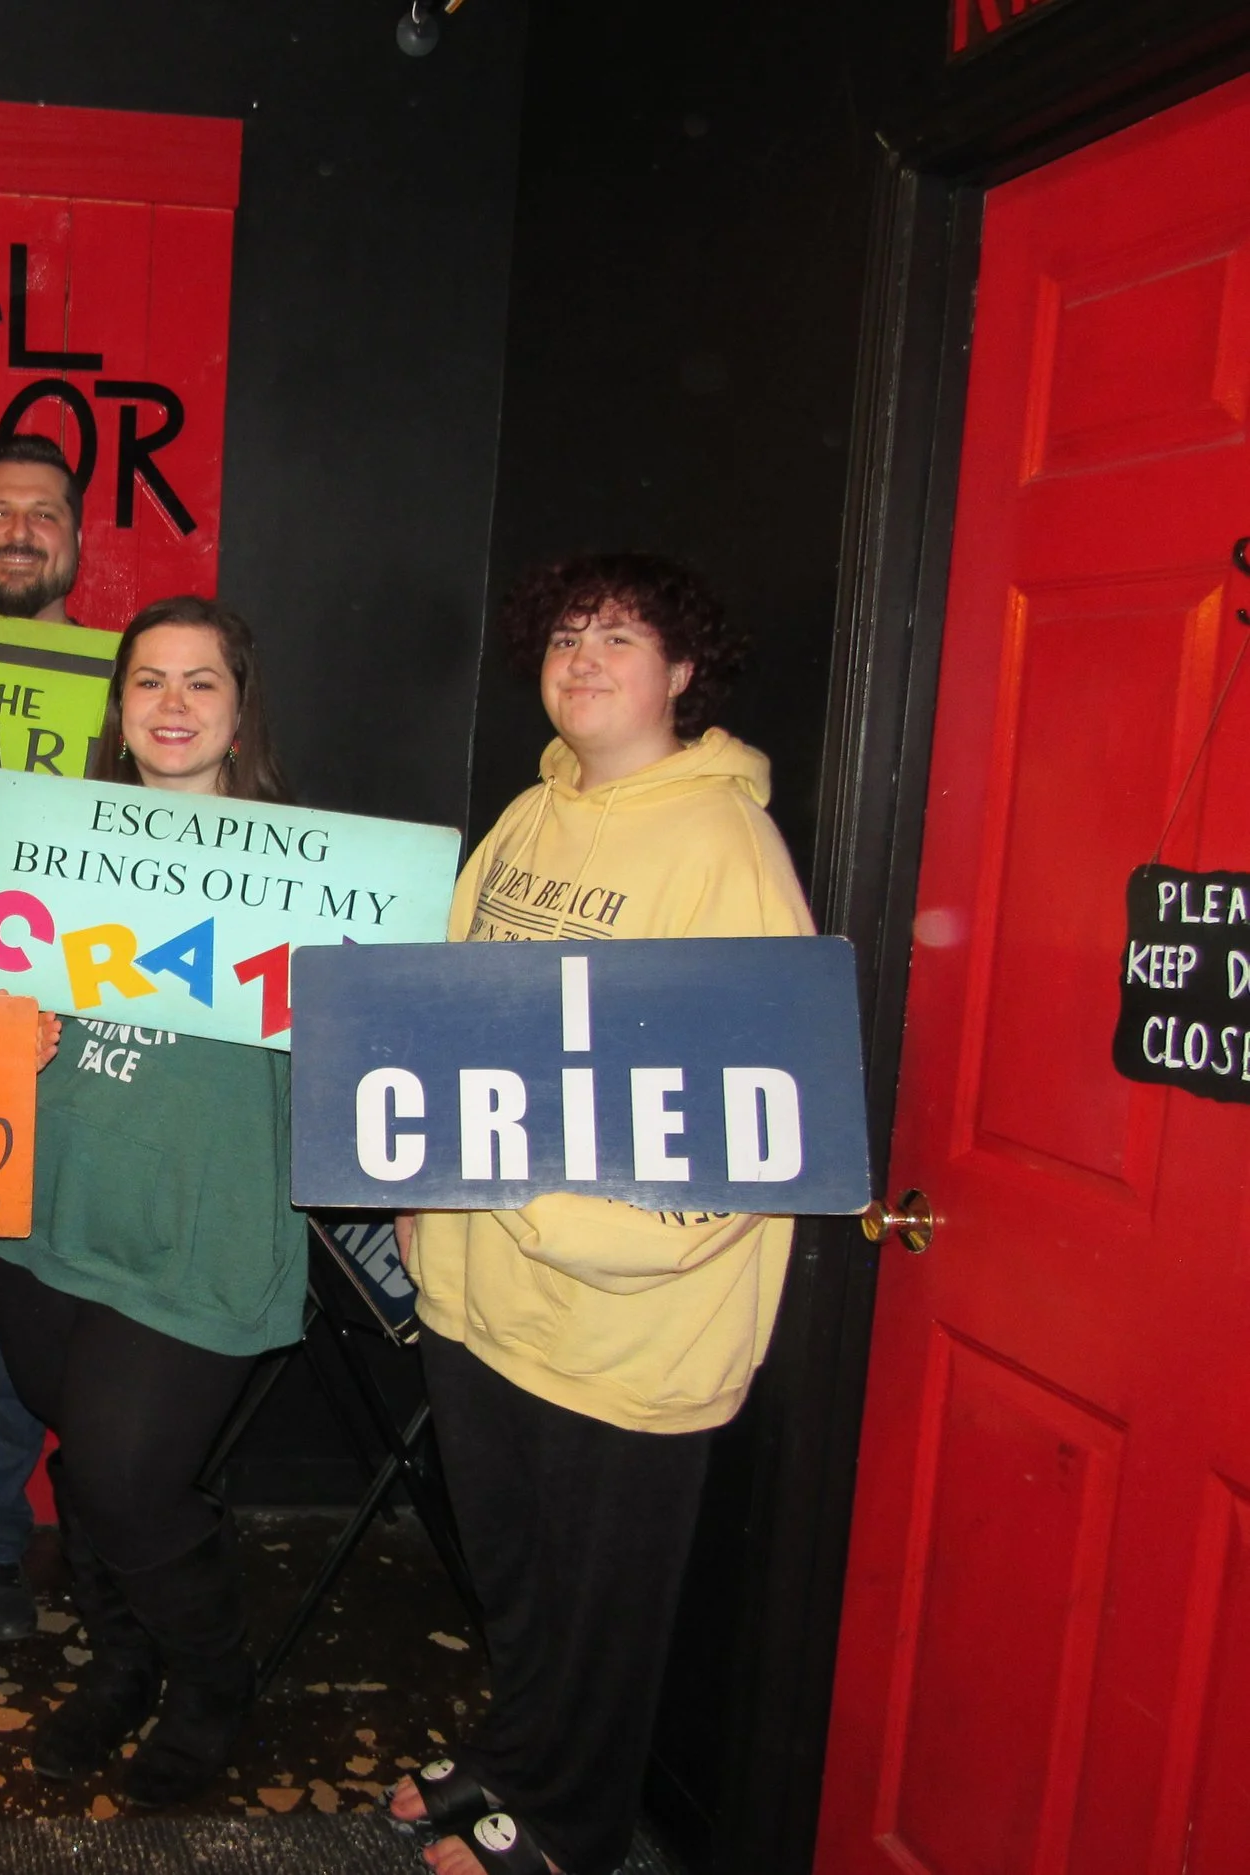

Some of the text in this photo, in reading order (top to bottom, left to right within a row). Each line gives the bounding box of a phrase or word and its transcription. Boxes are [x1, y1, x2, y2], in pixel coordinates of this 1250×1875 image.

[89, 799, 330, 863] ESCAPING
[11, 840, 398, 926] BRINGS OUT MY
[1158, 881, 1249, 924] PLEA
[1126, 940, 1196, 989] KEEP
[561, 956, 590, 1052] I
[77, 1040, 141, 1083] FACE
[356, 1067, 803, 1182] CRIED
